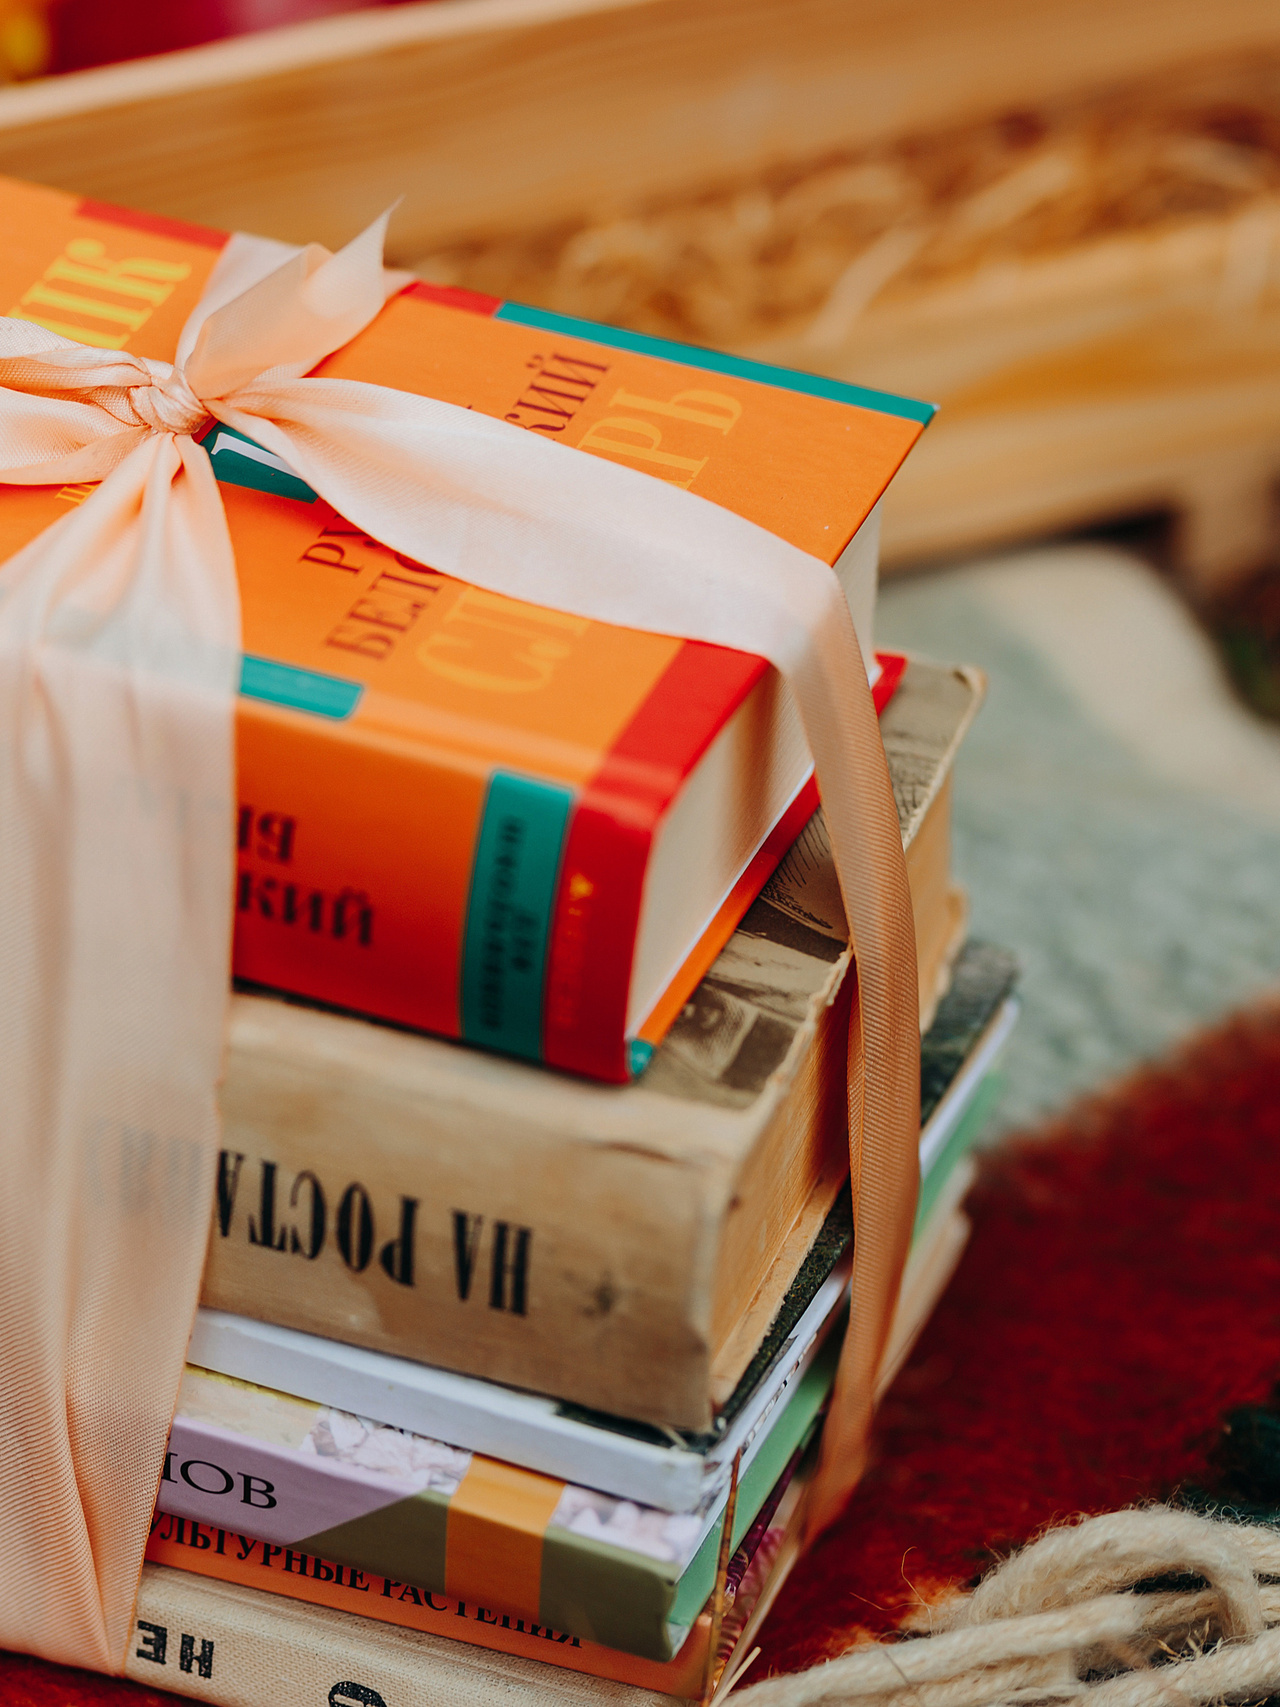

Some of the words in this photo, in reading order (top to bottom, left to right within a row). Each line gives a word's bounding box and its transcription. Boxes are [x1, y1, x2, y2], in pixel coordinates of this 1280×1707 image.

[575, 388, 742, 490] РЬ
[451, 1206, 533, 1317] НА
[137, 1621, 214, 1679] НЕ
